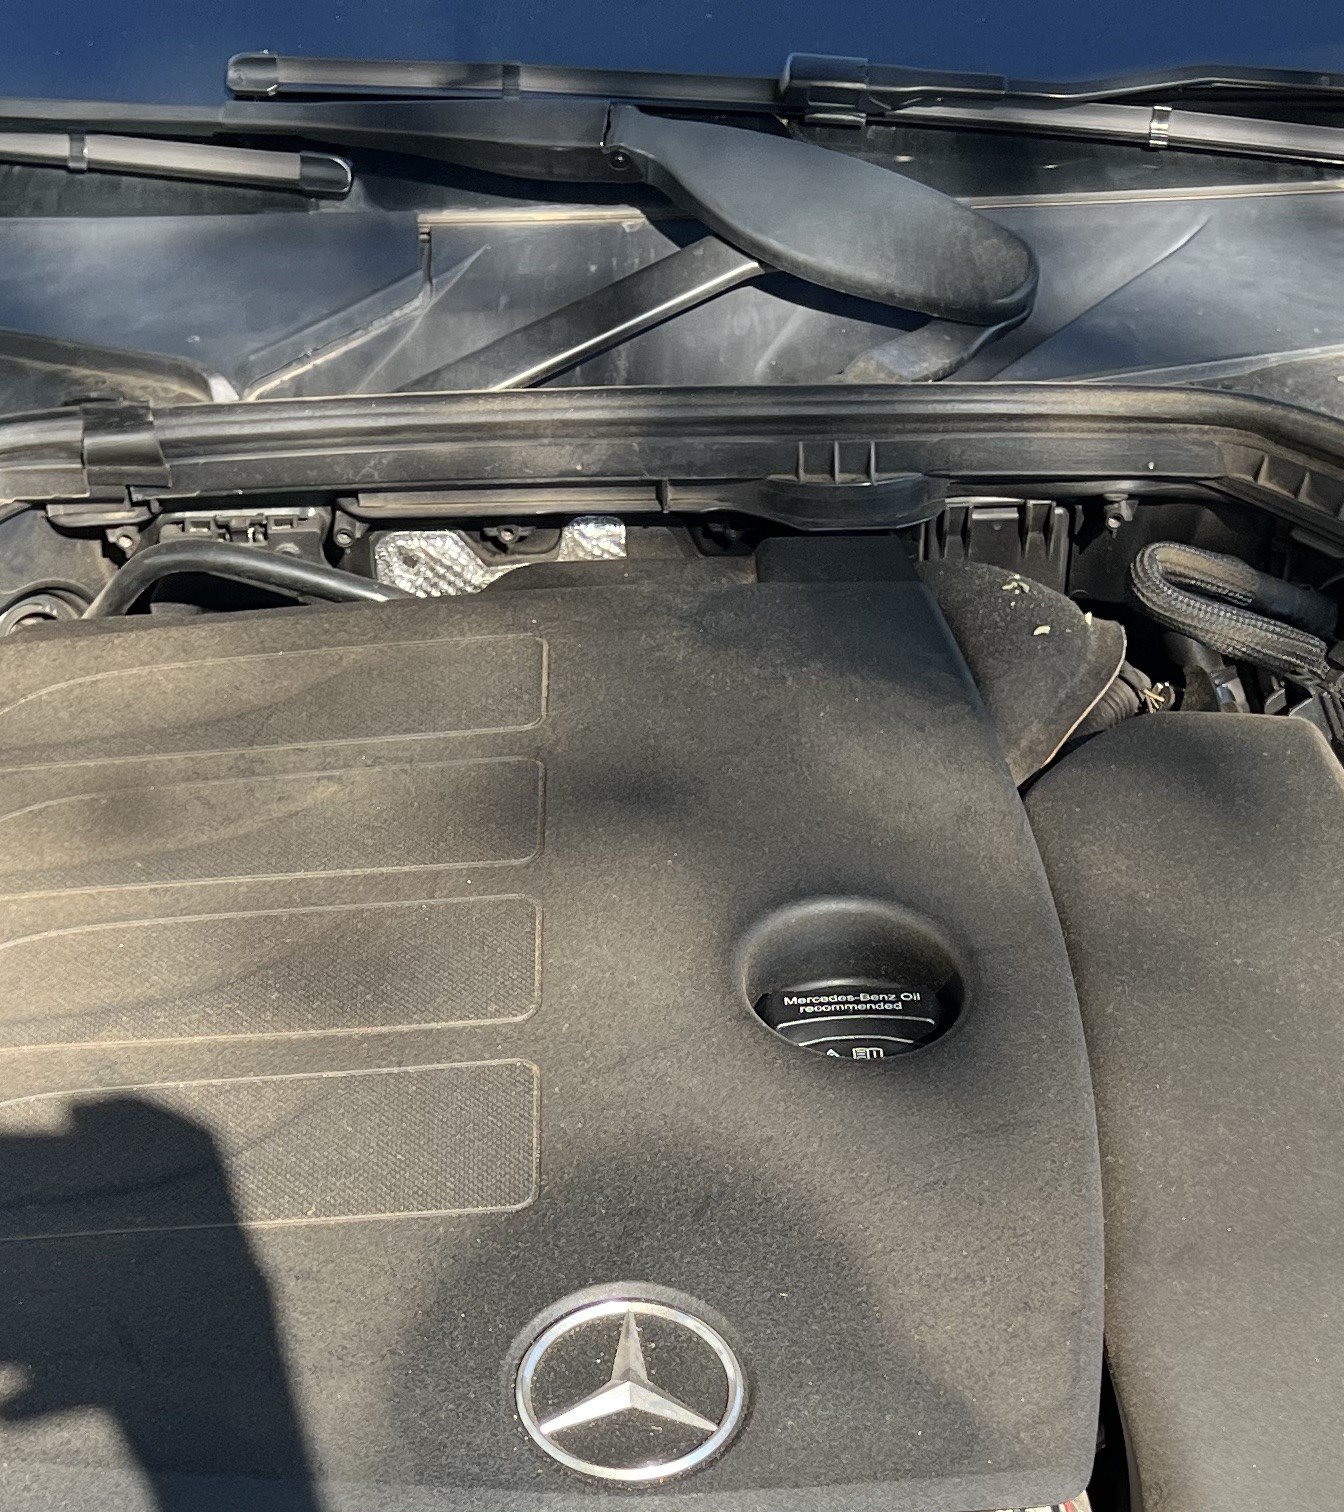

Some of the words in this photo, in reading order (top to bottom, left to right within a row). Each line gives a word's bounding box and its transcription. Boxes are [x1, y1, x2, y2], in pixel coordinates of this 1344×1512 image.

[783, 992, 896, 1006] Mercedes-Benz
[900, 992, 921, 1001] Oil
[799, 1001, 902, 1013] recommended
